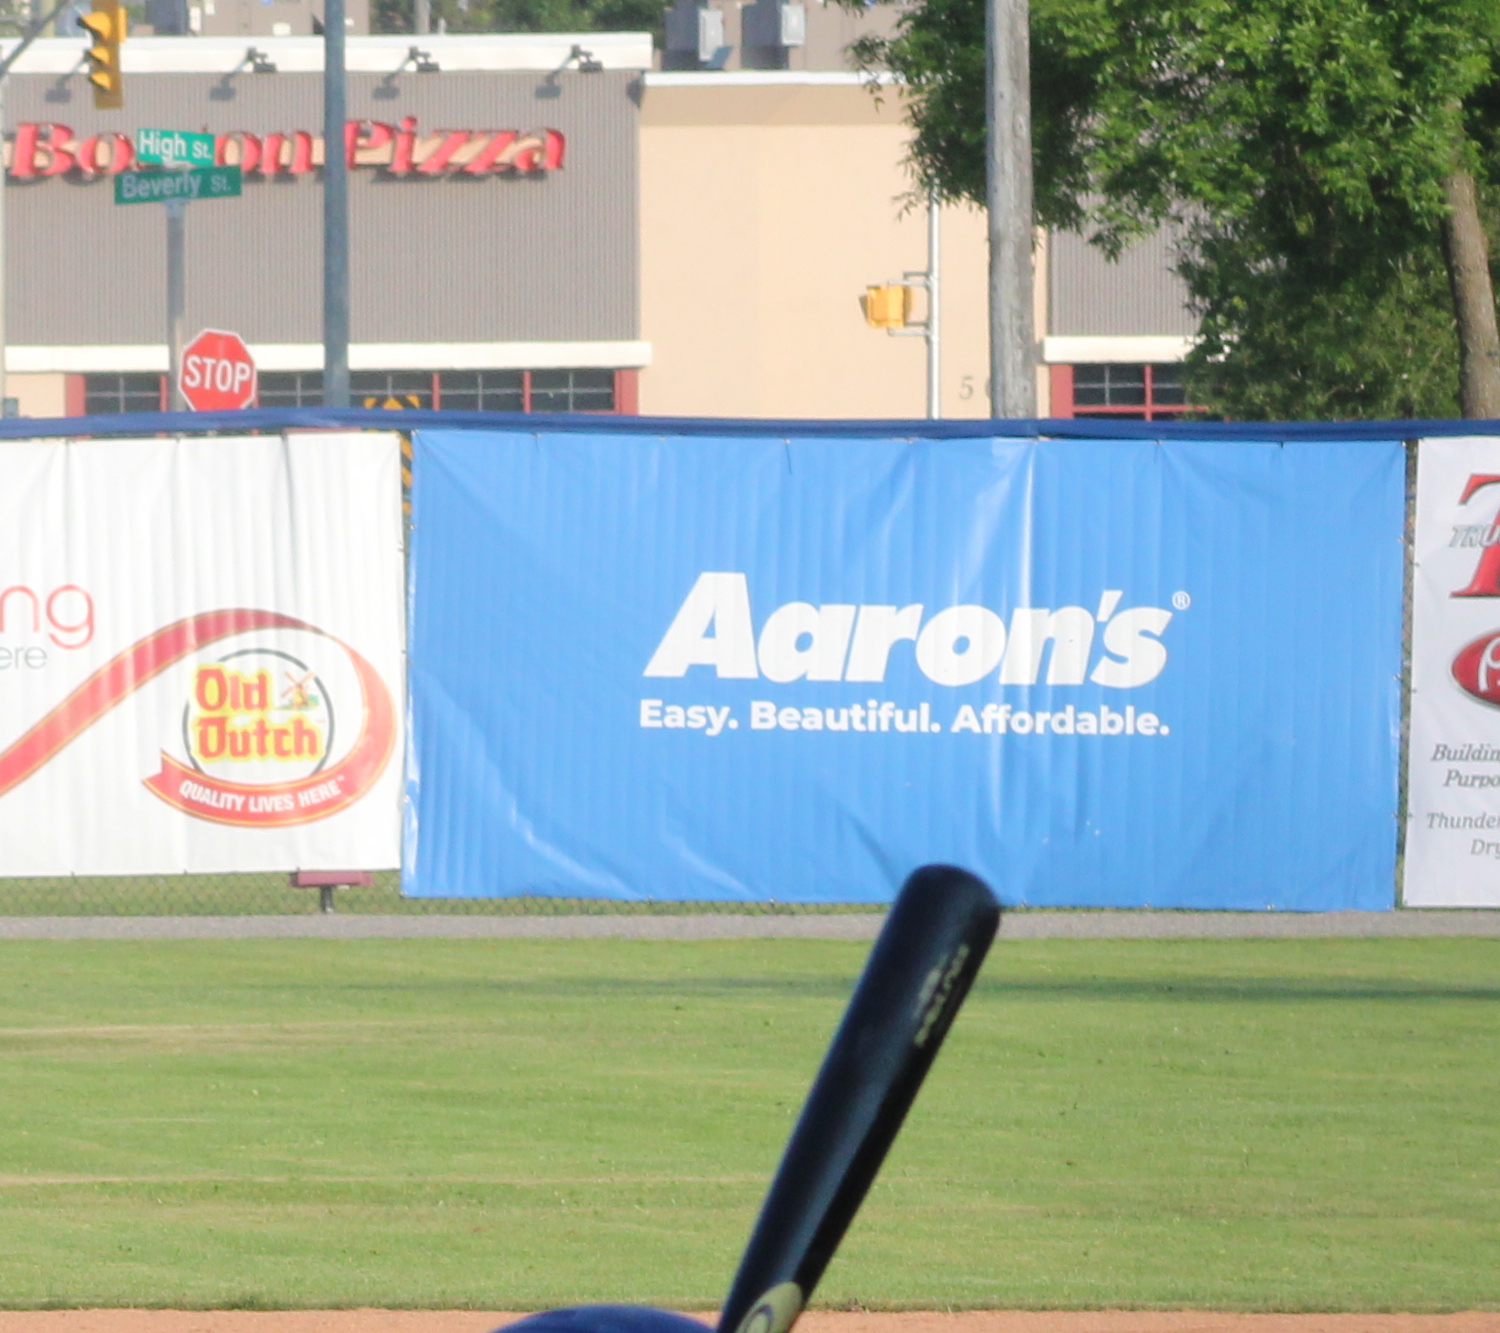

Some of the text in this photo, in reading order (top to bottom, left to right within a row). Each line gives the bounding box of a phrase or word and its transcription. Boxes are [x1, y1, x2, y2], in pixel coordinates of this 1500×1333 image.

[9, 115, 566, 177] Boon Pizza
[140, 129, 187, 161] High
[122, 173, 202, 199] Beverly
[184, 354, 252, 394] STOP
[196, 668, 269, 712] Old
[197, 716, 318, 758] Dutch
[639, 700, 1171, 736] Easy. Beautiful. Affordable.
[178, 779, 246, 812] QUALITY
[248, 793, 295, 813] LIVES
